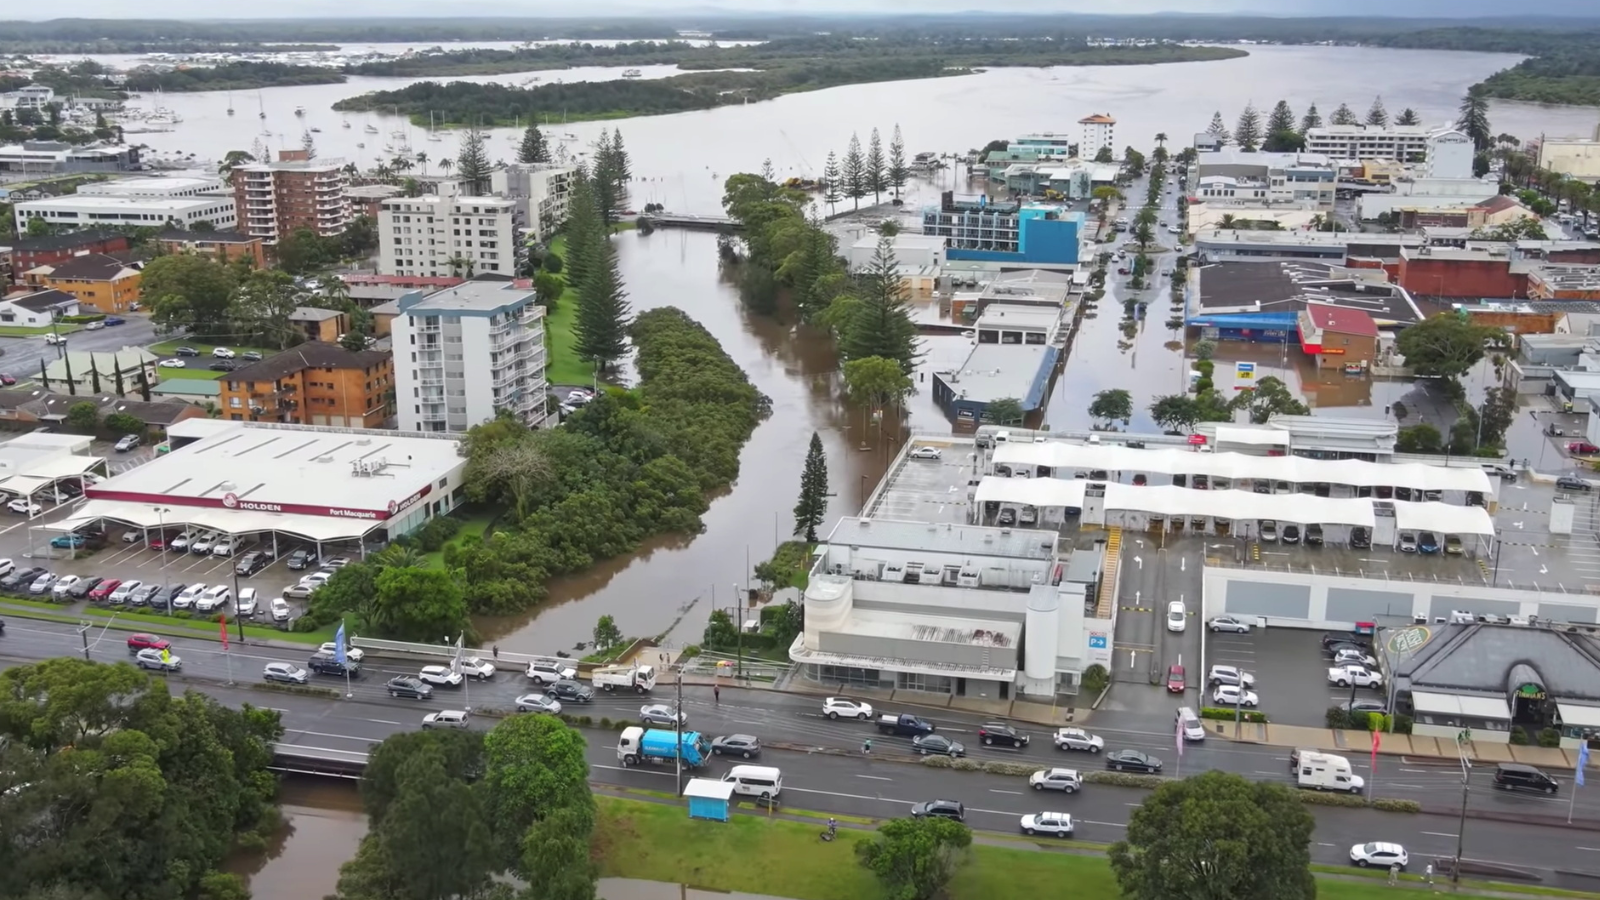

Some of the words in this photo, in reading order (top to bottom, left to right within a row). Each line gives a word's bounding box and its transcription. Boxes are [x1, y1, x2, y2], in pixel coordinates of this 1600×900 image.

[399, 492, 421, 510] HOLDEN
[240, 502, 281, 511] HOLDEN
[344, 509, 376, 518] Macquarie
